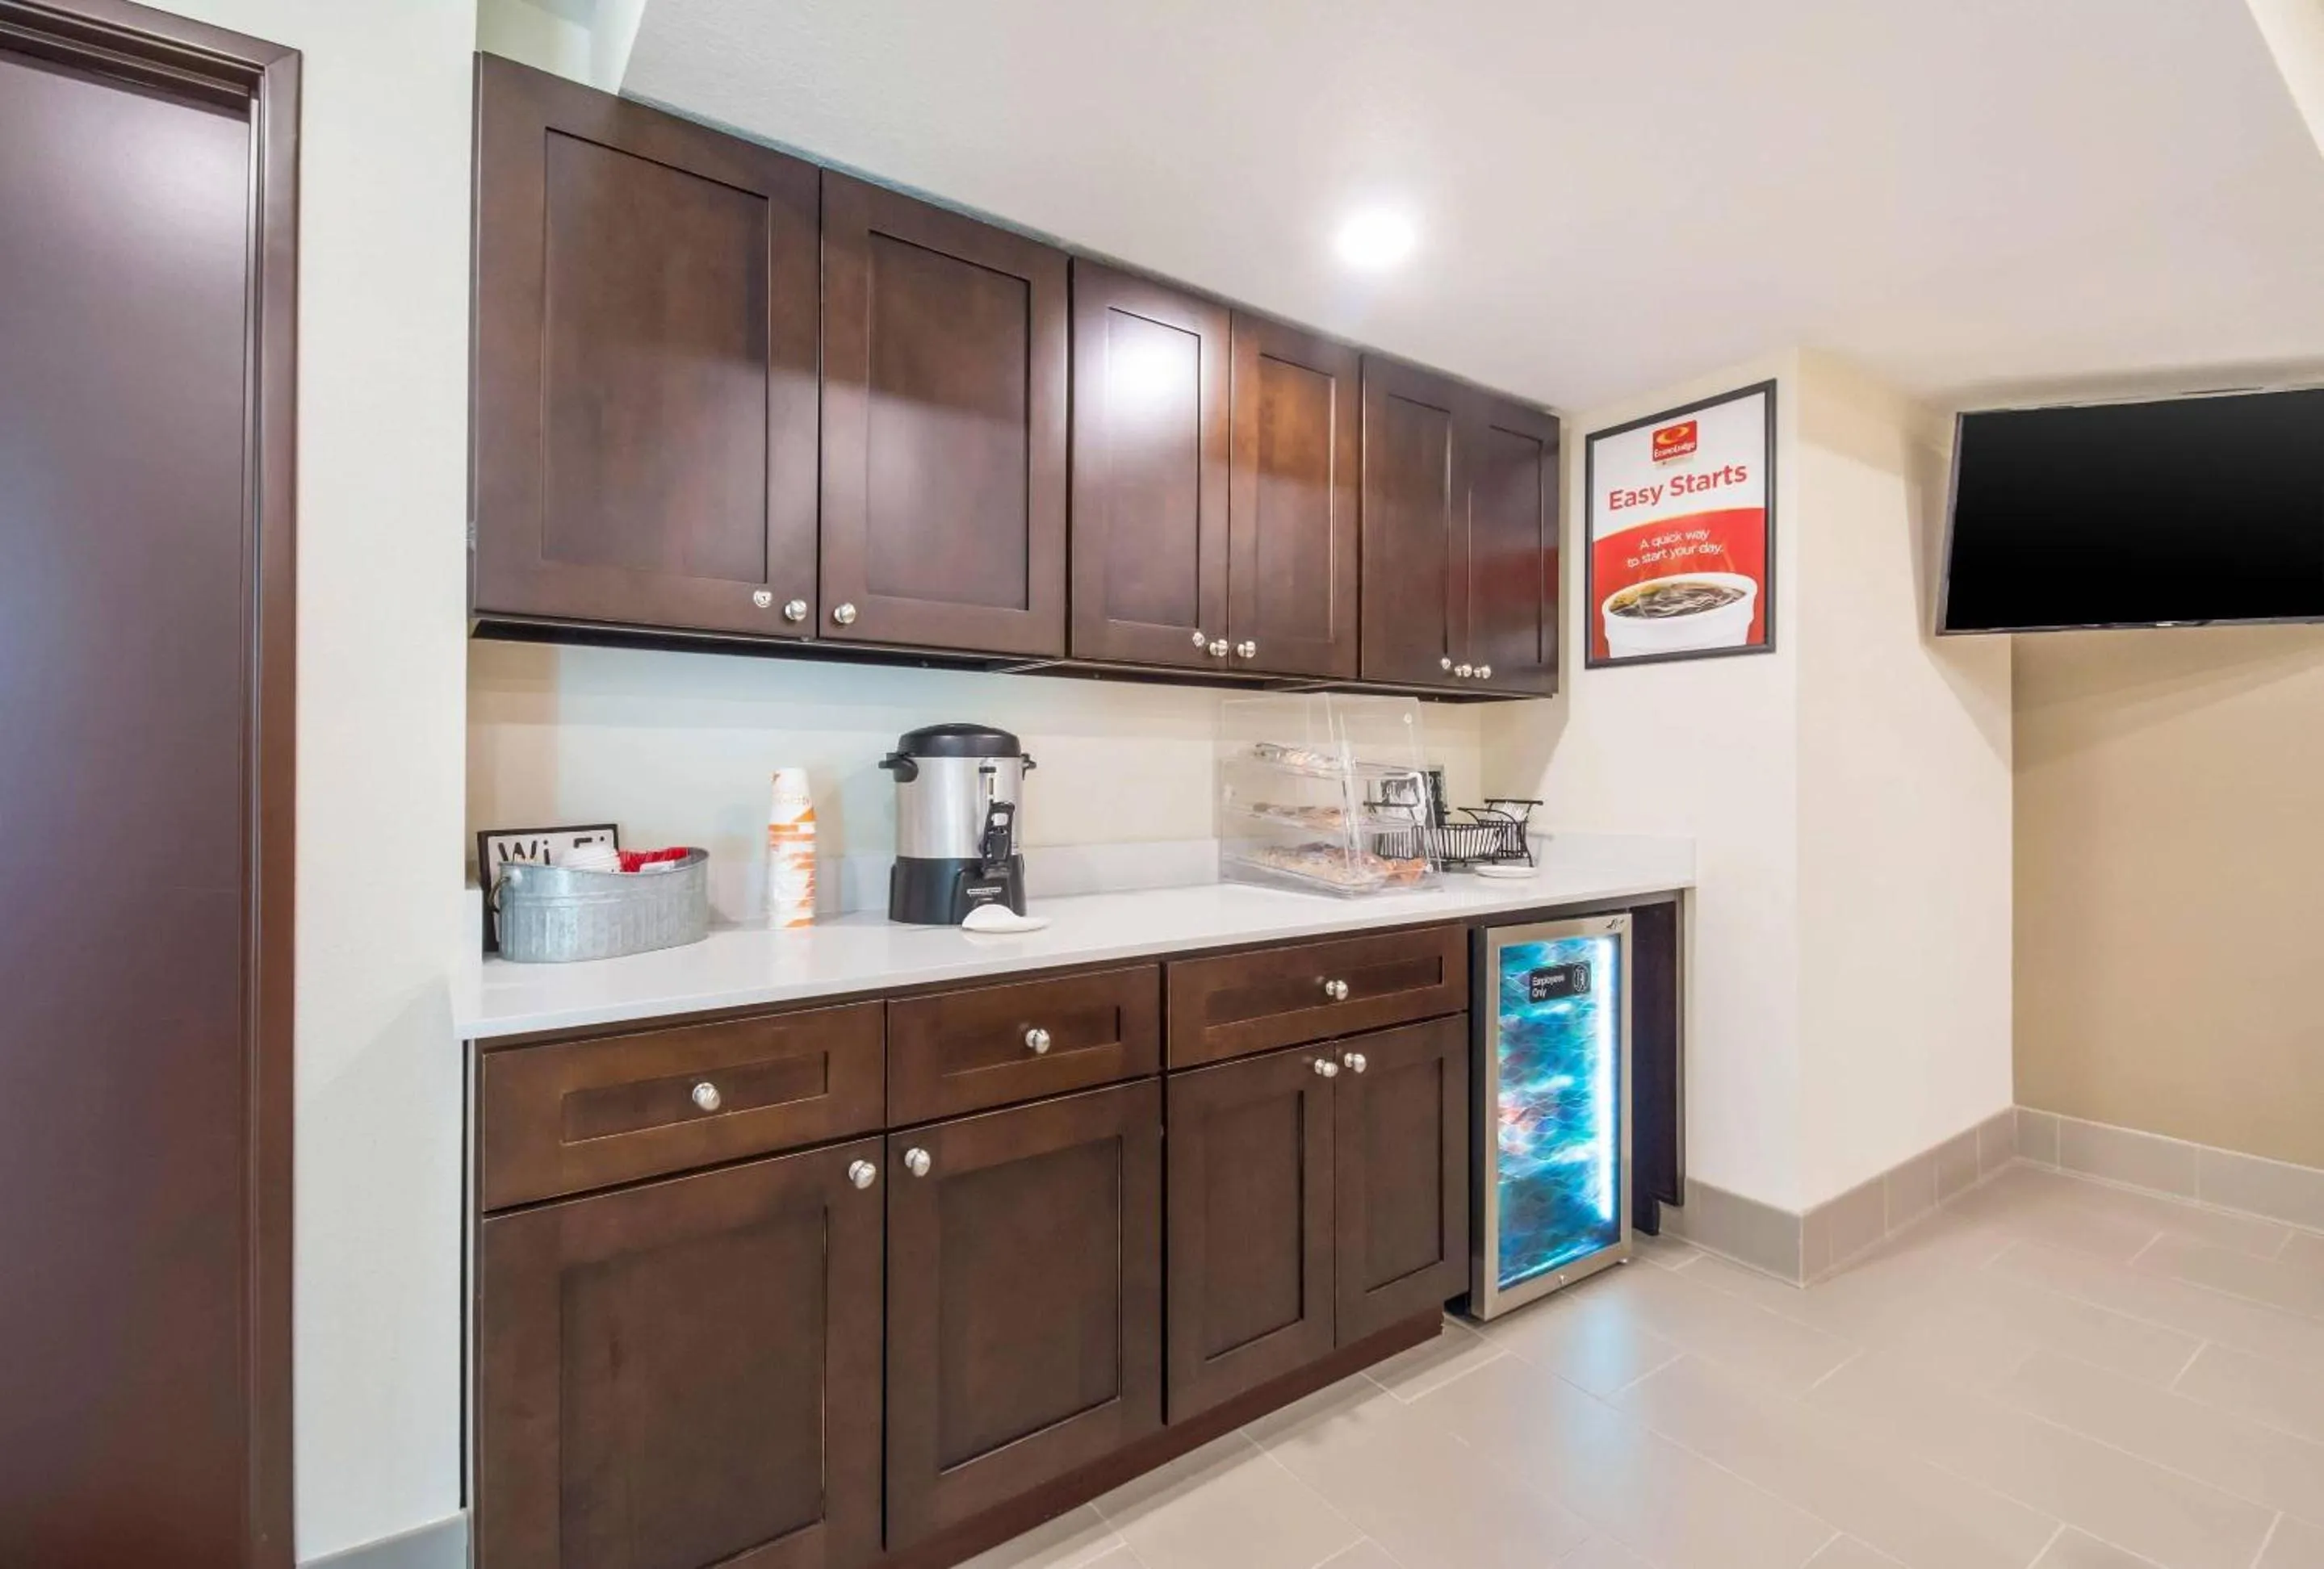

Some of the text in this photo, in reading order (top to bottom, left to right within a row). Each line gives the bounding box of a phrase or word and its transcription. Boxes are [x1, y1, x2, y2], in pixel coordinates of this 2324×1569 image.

[1609, 465, 1748, 510] Easy Starts
[1639, 529, 1711, 550] A quick way
[1627, 558, 1639, 567] to
[1641, 549, 1669, 564] start
[1668, 545, 1696, 560] your
